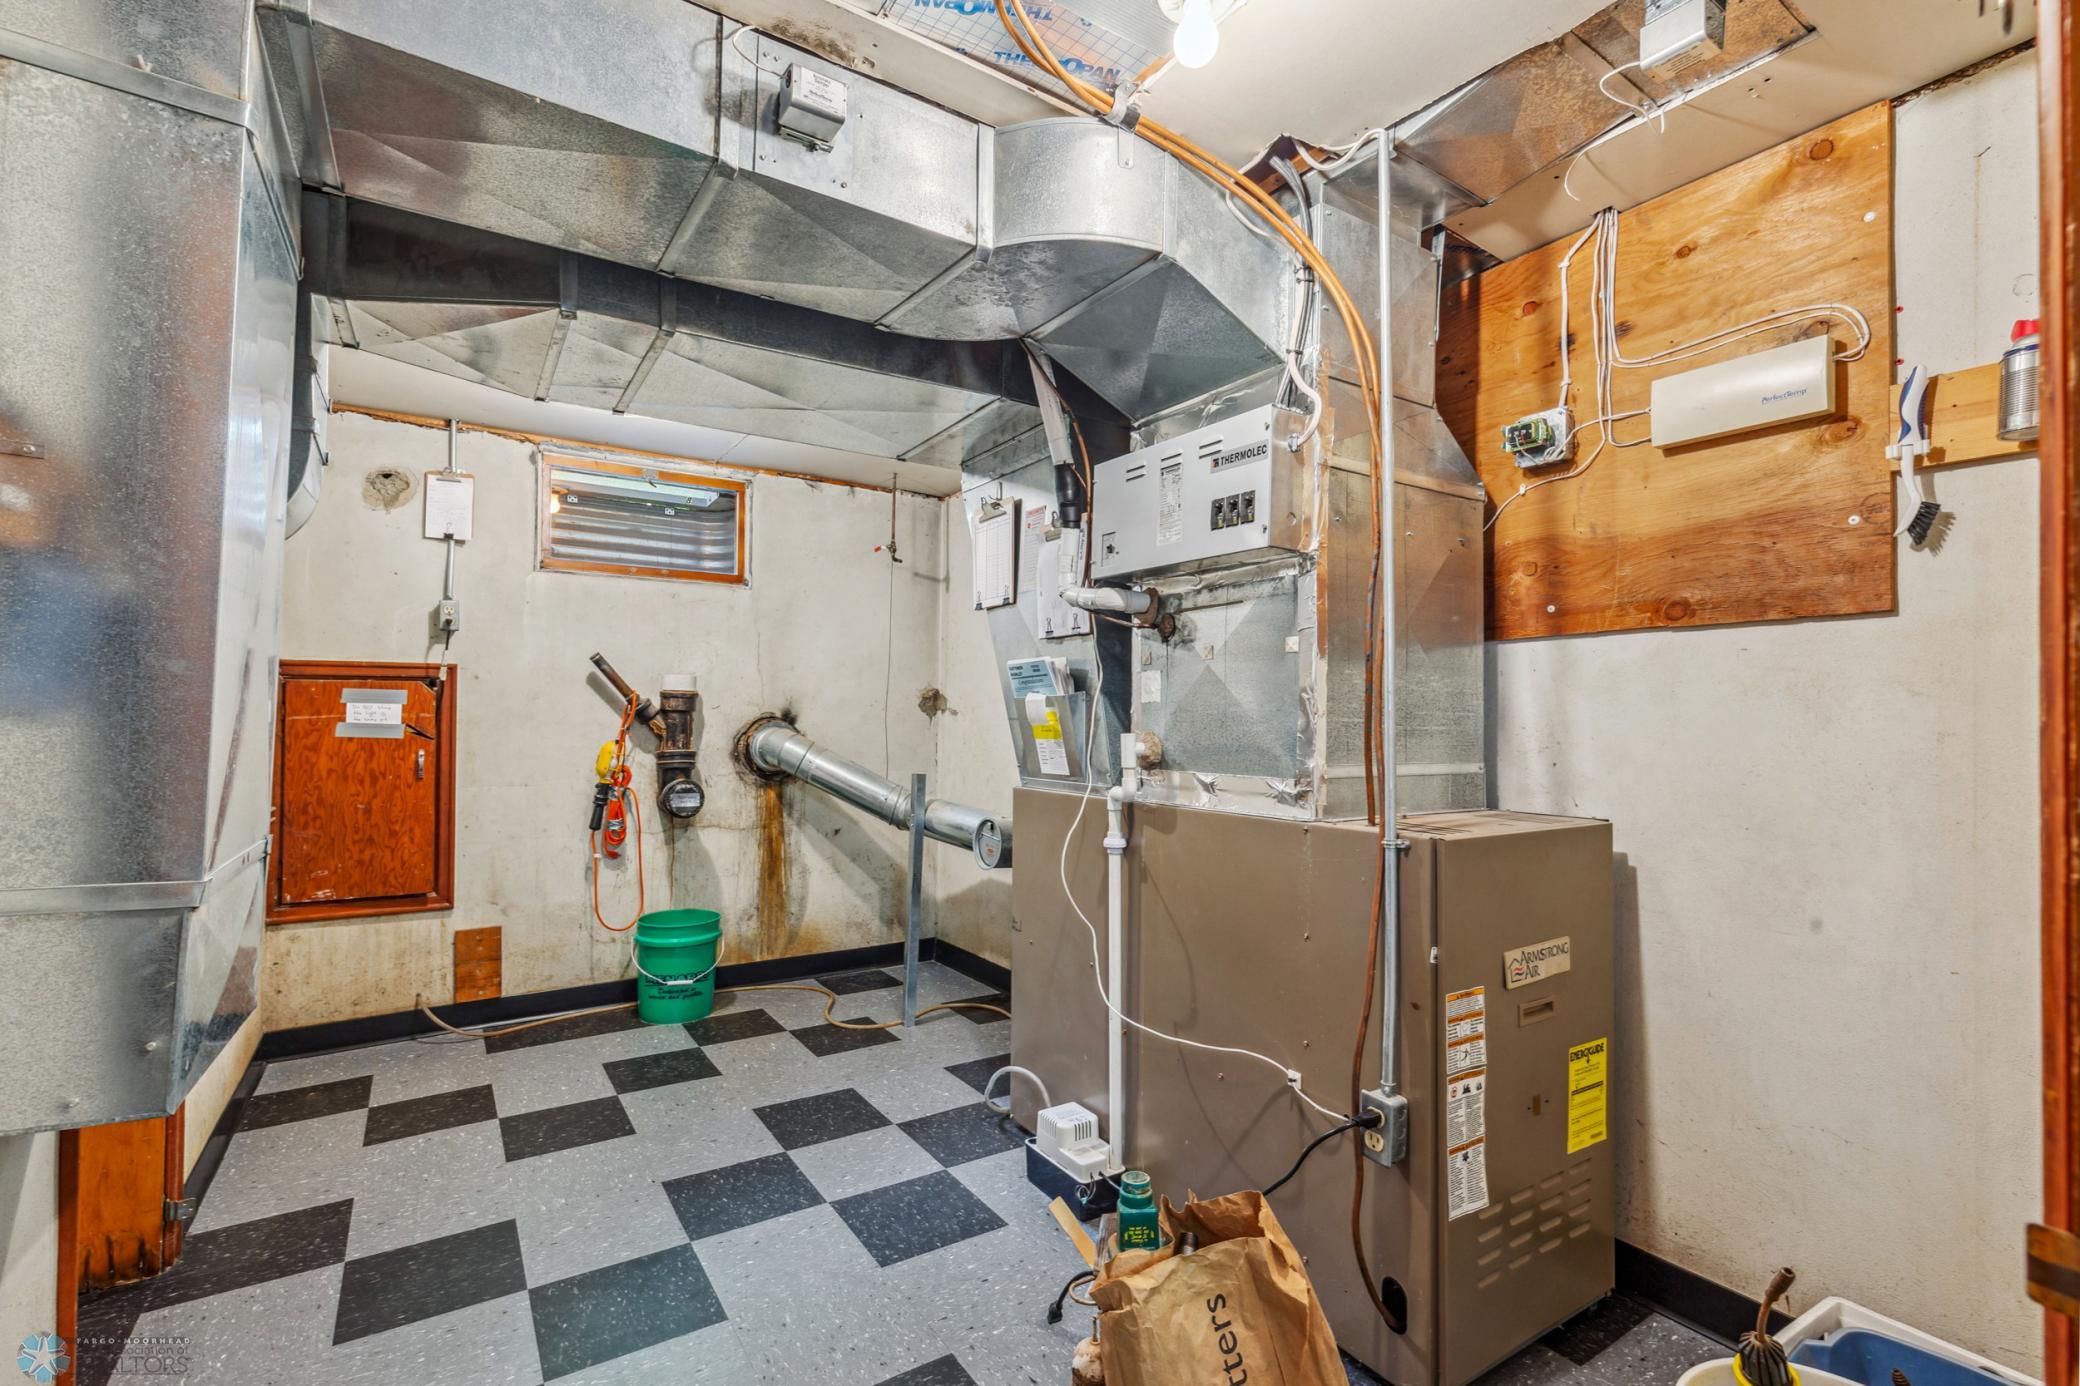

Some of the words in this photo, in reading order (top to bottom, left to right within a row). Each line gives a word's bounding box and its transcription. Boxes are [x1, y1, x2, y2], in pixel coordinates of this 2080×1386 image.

[1220, 444, 1268, 466] THERMOLEC
[1521, 942, 1569, 964] ARMSTRONG
[1525, 965, 1541, 980] AIR
